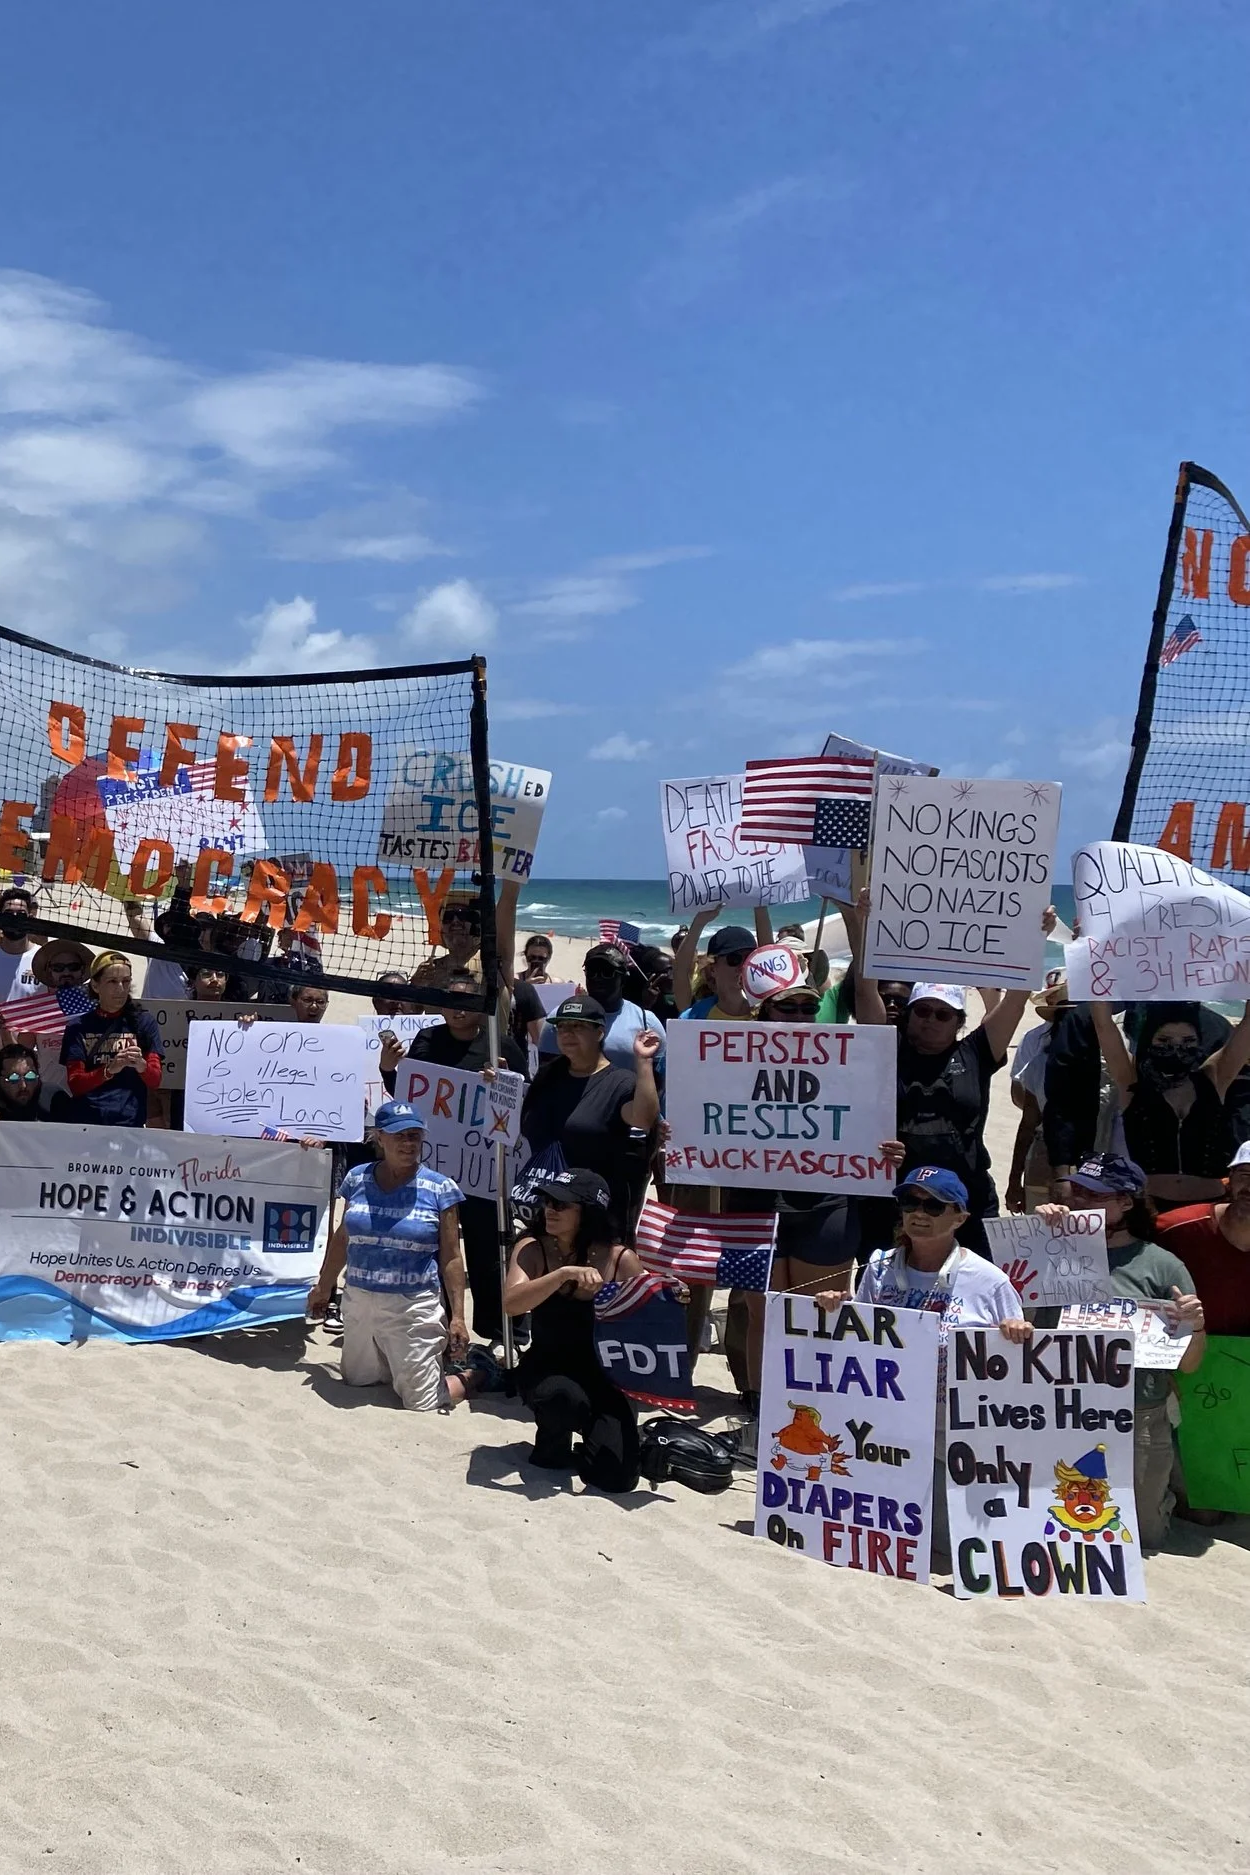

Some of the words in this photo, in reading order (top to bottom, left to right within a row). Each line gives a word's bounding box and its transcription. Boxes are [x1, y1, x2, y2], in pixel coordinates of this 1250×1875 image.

[47, 700, 372, 802] DEFEND
[416, 794, 516, 840] ICE
[665, 781, 742, 833] DEATH
[888, 803, 941, 835] NO
[946, 808, 1037, 845] KINGS
[380, 832, 451, 860] TASTES
[884, 844, 937, 876] NO
[940, 847, 1050, 884] FASCISTS
[669, 868, 734, 913] POWER
[732, 865, 754, 895] TO
[752, 857, 781, 886] THE
[758, 880, 810, 906] PEOPLE
[880, 882, 933, 914] NO
[937, 887, 1022, 918] NAZIS
[1089, 898, 1114, 933] 4
[876, 919, 930, 951] NO
[938, 921, 1008, 955] ICE
[1091, 960, 1118, 996] &
[1135, 960, 1175, 992] 34
[206, 1027, 245, 1058] NO
[371, 1018, 391, 1032] NO
[700, 1030, 855, 1066] PERSIST
[194, 1081, 276, 1106] Stolen
[330, 1071, 358, 1084] on
[751, 1069, 821, 1104] AND
[279, 1095, 343, 1125] Land
[703, 1102, 851, 1141] RESIST
[66, 1162, 124, 1176] BROWARD
[128, 1166, 176, 1180] COUNTY
[177, 1153, 242, 1191] Florida
[38, 1181, 110, 1214] HOPE
[118, 1184, 137, 1216] &
[148, 1188, 255, 1224] ACTION
[130, 1226, 252, 1252] INDIVISIBLE
[985, 1217, 1047, 1239] THEIR
[1051, 1213, 1103, 1239] BLOOD
[29, 1251, 68, 1267] Hope
[68, 1252, 113, 1268] Unites
[114, 1255, 136, 1270] Us.
[137, 1257, 184, 1273] Action
[185, 1261, 241, 1277] Defines
[267, 1242, 309, 1250] INDIVISIBLE
[1010, 1237, 1032, 1258] IS
[1045, 1239, 1078, 1255] ON
[54, 1269, 143, 1289] Democracy
[1051, 1255, 1099, 1277] YOUR
[783, 1297, 905, 1350] LIAR
[597, 1339, 689, 1378] FDT
[783, 1348, 906, 1402] LIAR
[955, 1330, 1009, 1382] No
[1022, 1330, 1132, 1389] KING
[949, 1387, 1046, 1431] Lives
[1054, 1388, 1133, 1433] Here
[1193, 1382, 1232, 1409] 86
[845, 1418, 911, 1467] Your
[947, 1441, 1032, 1509] Only
[762, 1470, 924, 1537] DIAPERS
[983, 1497, 1008, 1518] a
[766, 1513, 804, 1551] On
[822, 1520, 918, 1582] FIRE
[958, 1536, 1128, 1597] CLOWN
